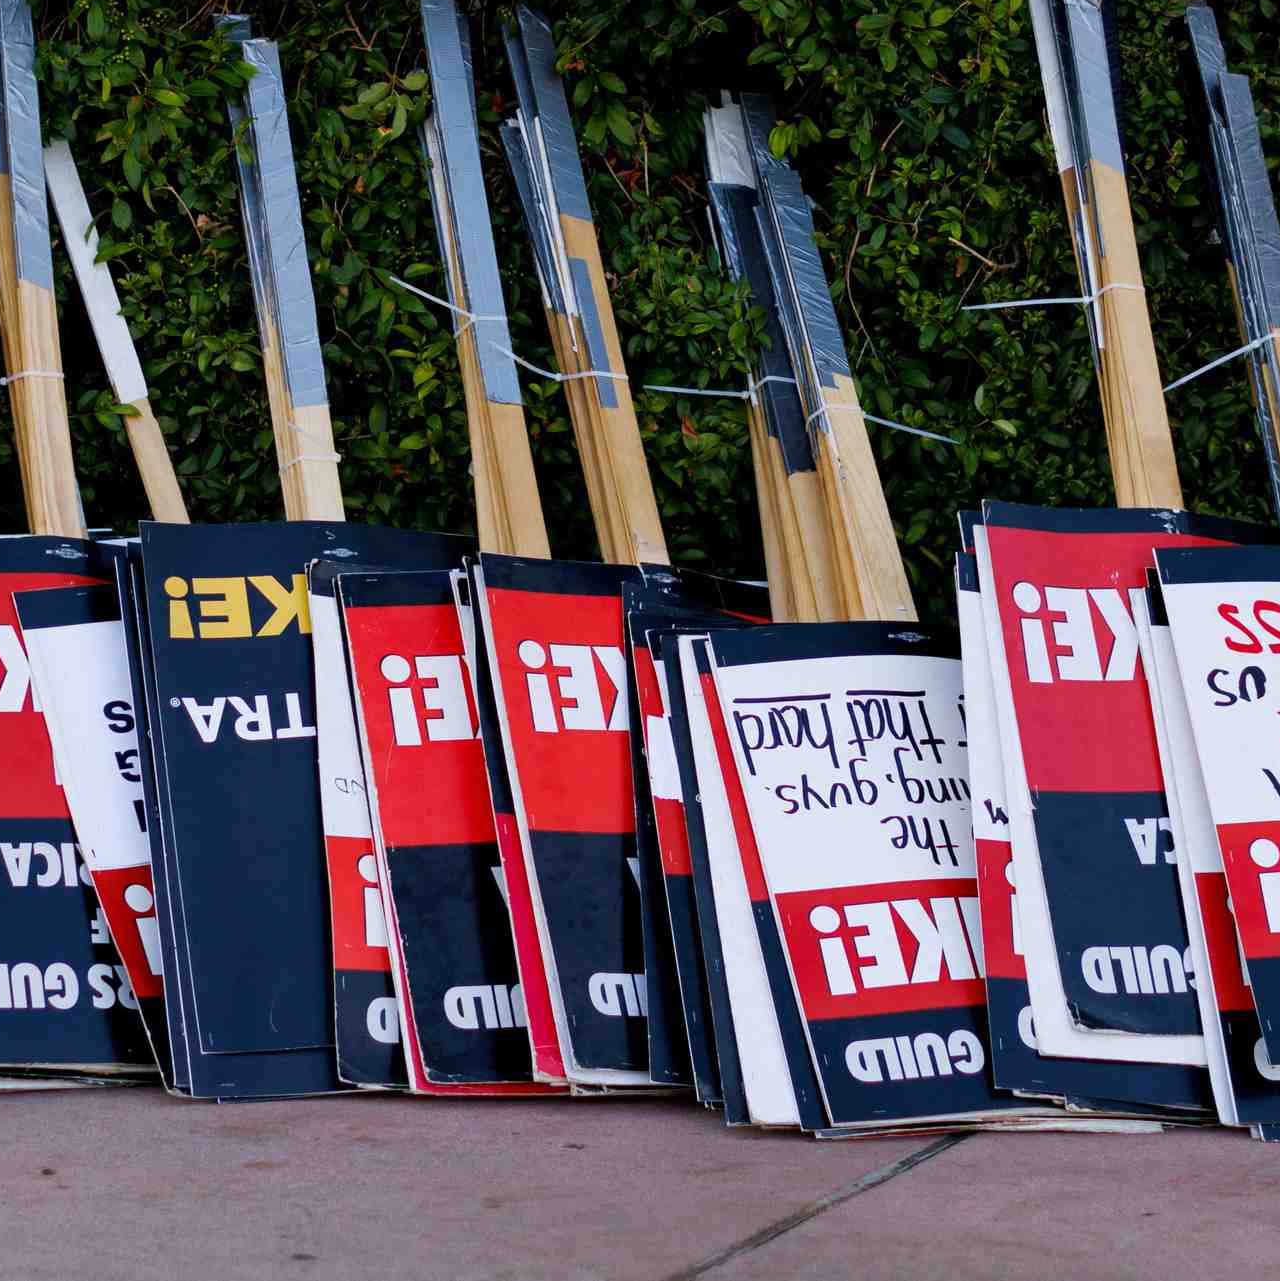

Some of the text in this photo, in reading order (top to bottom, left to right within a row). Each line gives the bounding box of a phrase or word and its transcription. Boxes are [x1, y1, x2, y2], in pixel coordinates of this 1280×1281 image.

[1207, 665, 1267, 707] US
[733, 706, 840, 776] hard
[848, 696, 944, 764] that
[881, 814, 959, 867] the
[845, 1029, 985, 1083] GUILD
